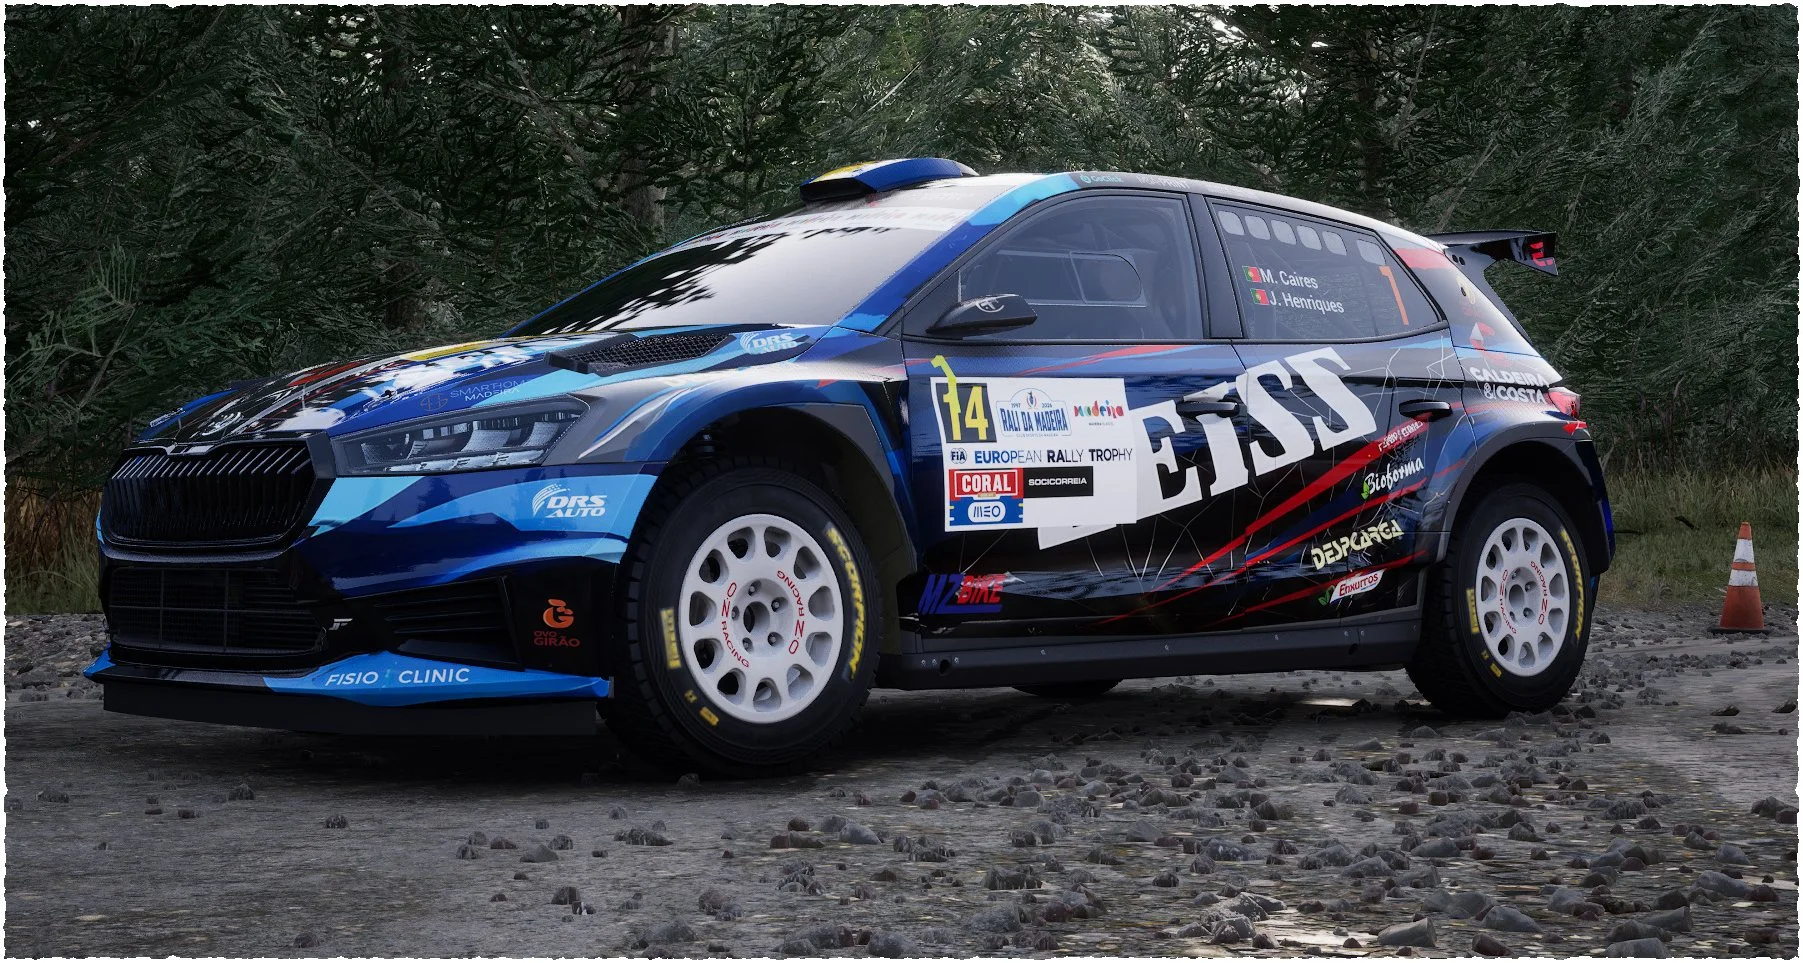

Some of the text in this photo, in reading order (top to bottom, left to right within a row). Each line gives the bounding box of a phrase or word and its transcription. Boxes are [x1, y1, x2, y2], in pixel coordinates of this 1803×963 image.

[1260, 268, 1319, 289] M. Caires
[1269, 290, 1345, 315] J. Henriques
[1469, 366, 1550, 387] CALDEIRA
[1000, 407, 1069, 432] RALI DA MADEIRA
[974, 449, 1042, 464] EUROPEAN
[1047, 448, 1085, 463] RALLY
[1089, 448, 1133, 463] TROPHY
[961, 474, 1012, 493] CORAL
[1028, 477, 1087, 486] SOCICORREIA
[1365, 457, 1425, 495] Bioforma
[547, 495, 608, 508] DRS
[545, 507, 606, 518] AUTO
[777, 569, 804, 618] RACING
[533, 630, 557, 638] OVO
[533, 636, 581, 648] GIRÃO
[721, 620, 749, 668] RACING
[325, 668, 471, 687] FISIO CLINIC
